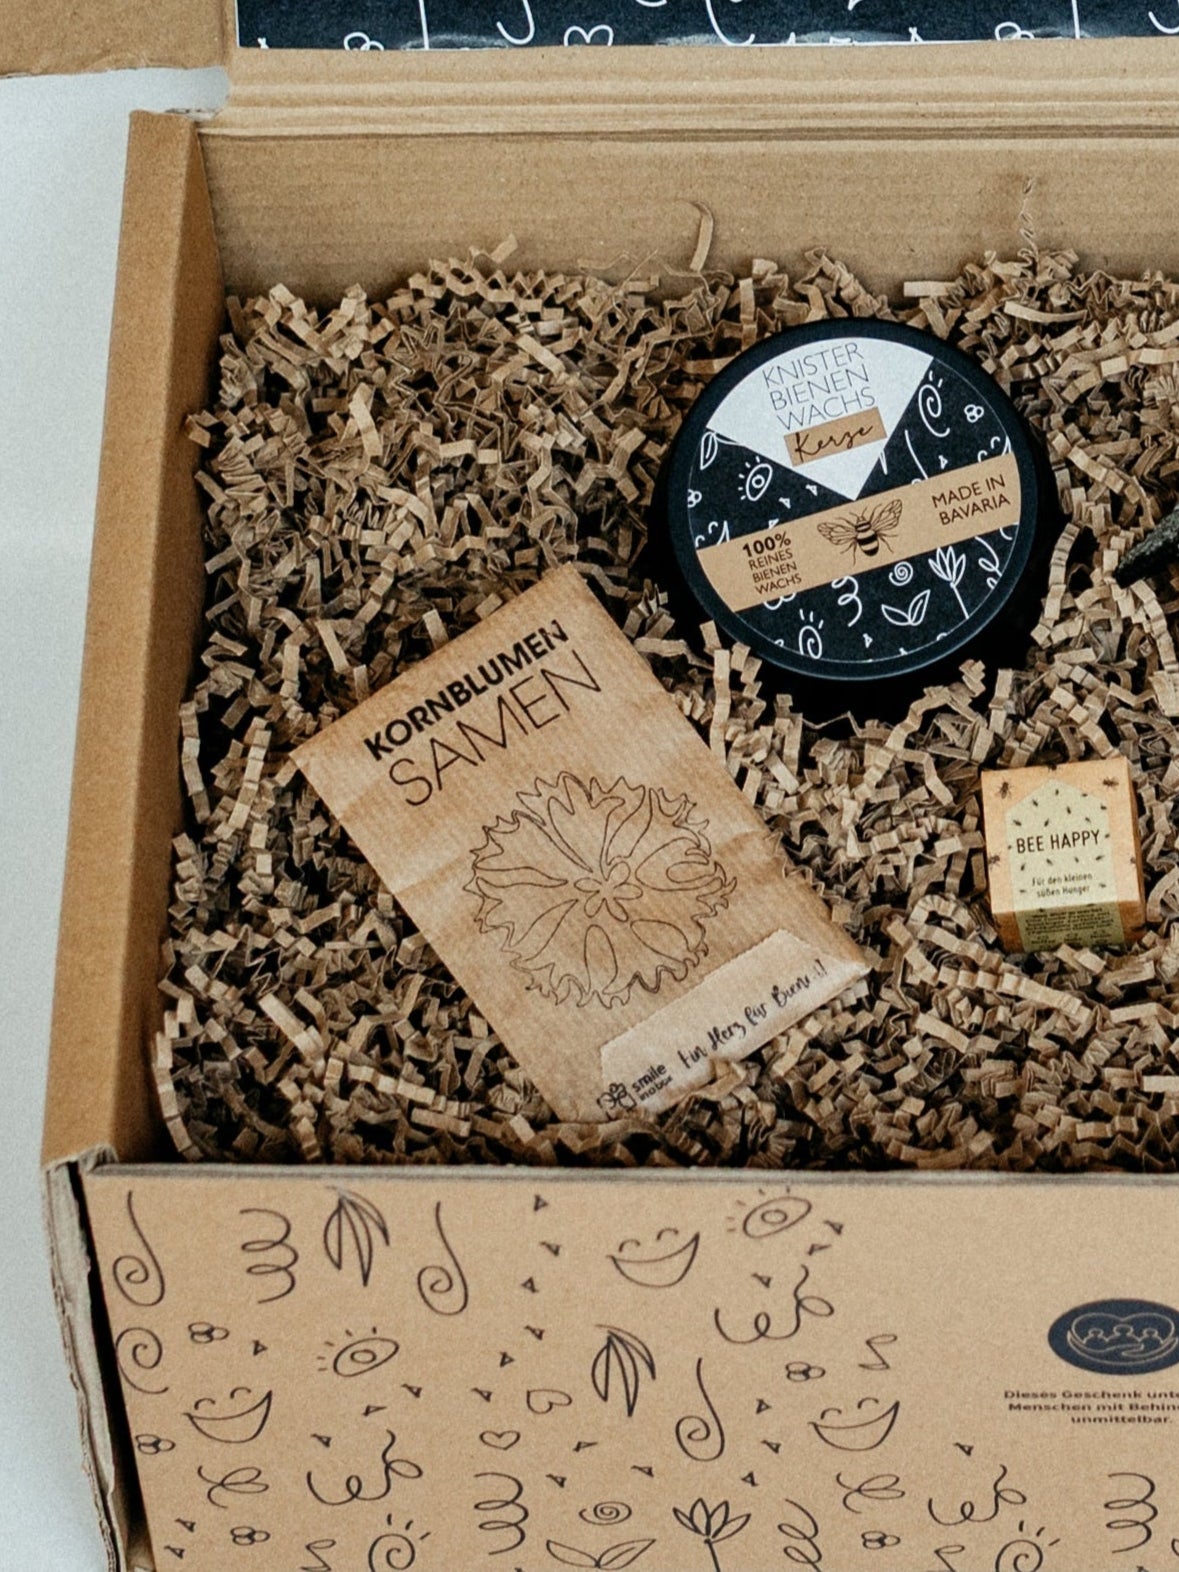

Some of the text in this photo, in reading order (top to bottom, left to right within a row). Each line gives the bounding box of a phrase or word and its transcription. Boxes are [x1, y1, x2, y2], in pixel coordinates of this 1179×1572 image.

[762, 342, 864, 388] KNISTER
[770, 363, 869, 411] BIENEN
[777, 386, 875, 430] WACHS
[795, 425, 873, 463] Kerze
[931, 474, 1005, 508] MADE IN
[939, 493, 1011, 525] BAVARIA
[742, 531, 791, 557] 100%
[748, 548, 793, 570] REINES
[752, 561, 797, 583] BIENEN
[754, 573, 802, 595] WACHS
[363, 618, 569, 762] KORNBLUMEN
[389, 649, 601, 806] SAMEN
[1016, 829, 1100, 854] BEE HAPPY
[632, 1064, 667, 1092] smile
[1003, 1390, 1057, 1399] Dieses
[1062, 1390, 1143, 1399] Geschenk
[1008, 1402, 1092, 1412] Menschen
[1096, 1402, 1124, 1412] mit
